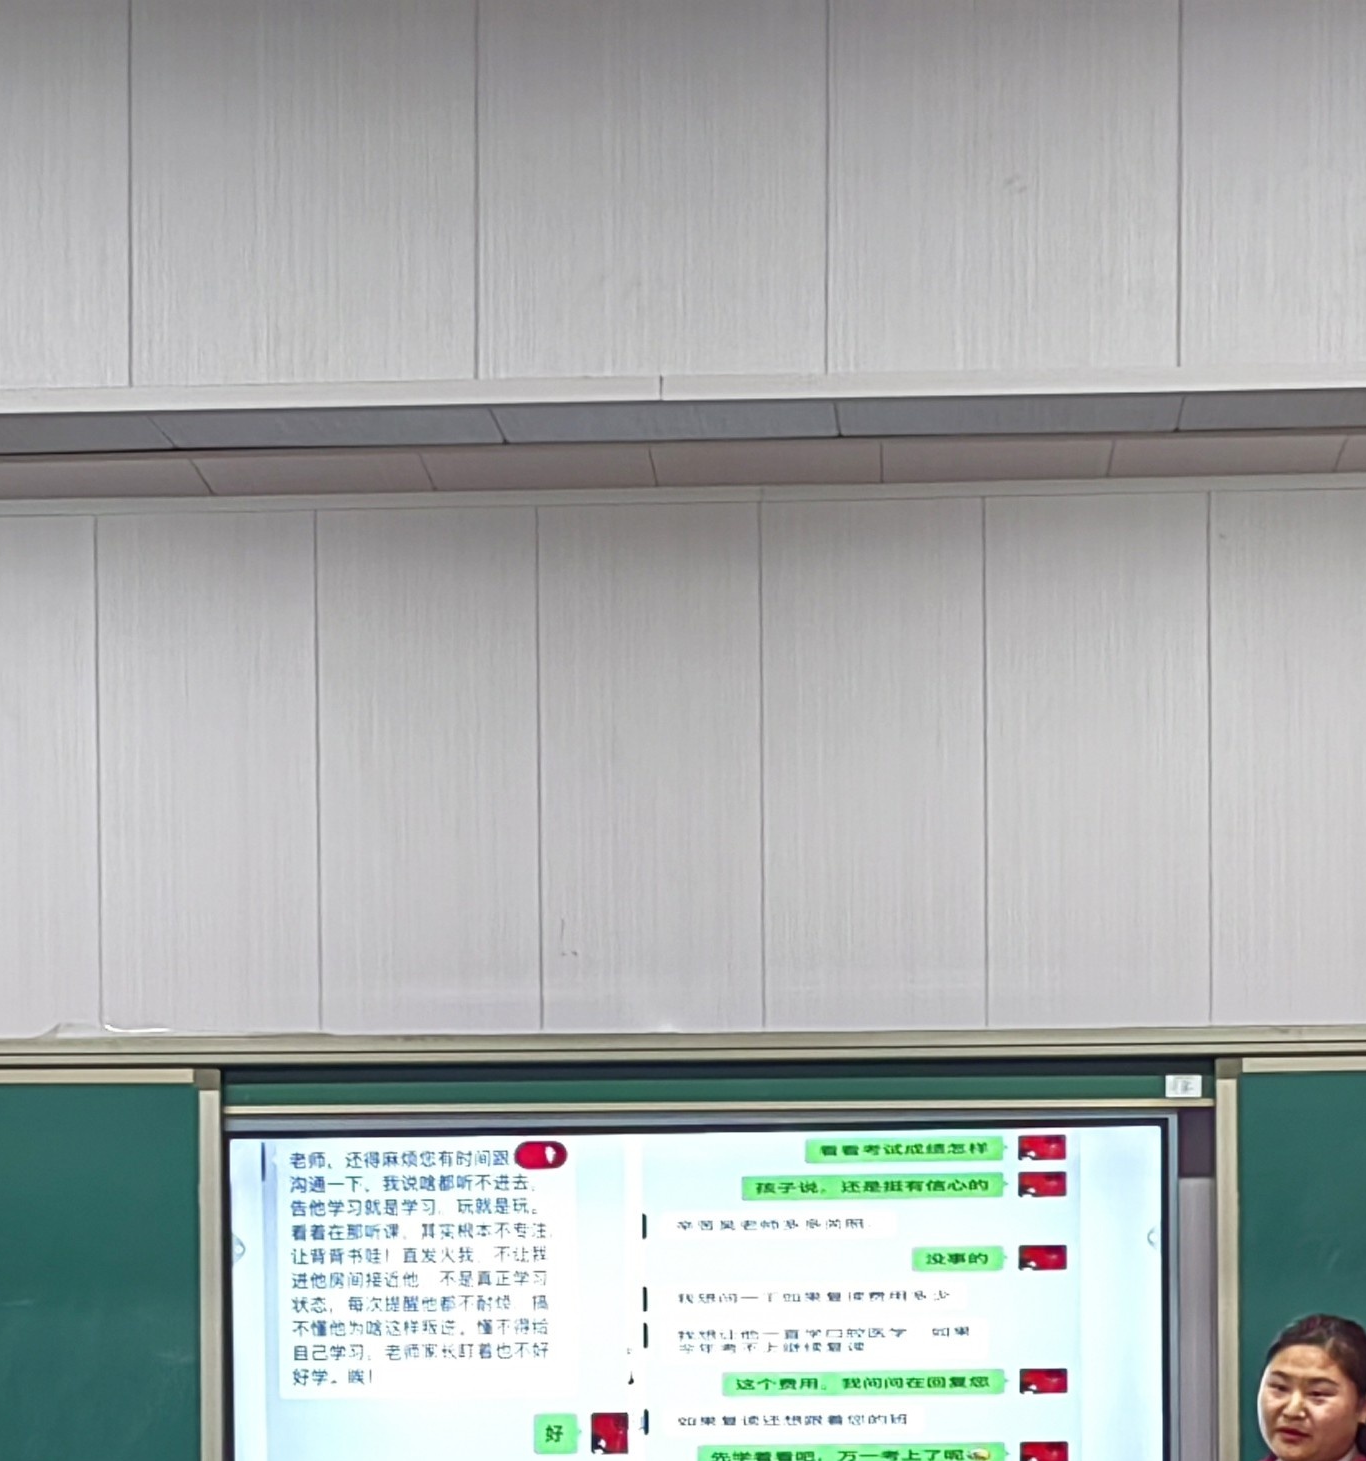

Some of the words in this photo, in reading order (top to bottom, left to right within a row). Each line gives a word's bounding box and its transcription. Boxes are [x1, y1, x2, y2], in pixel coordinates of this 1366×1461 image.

[926, 1252, 989, 1265] 没事的
[545, 1424, 564, 1443] 好
